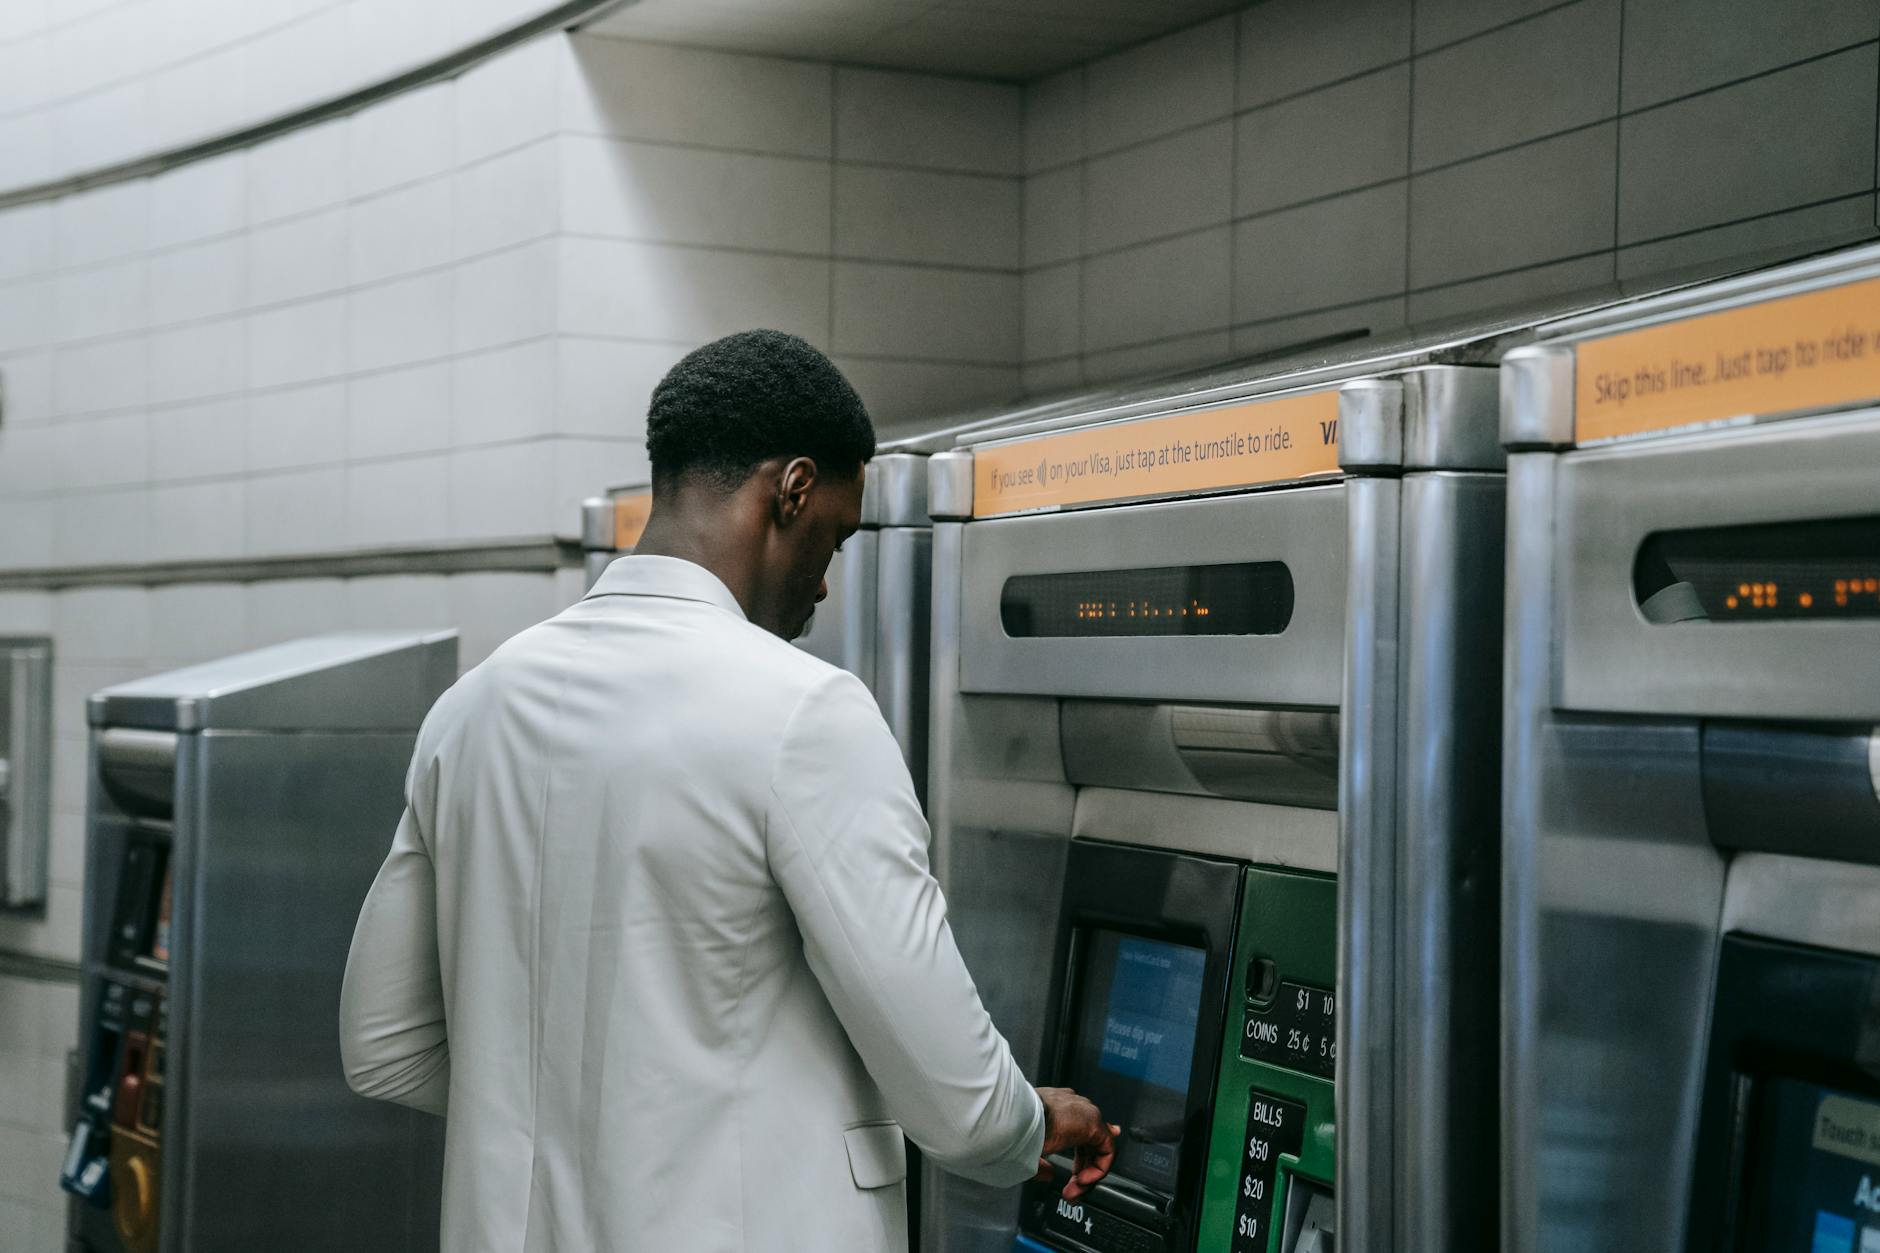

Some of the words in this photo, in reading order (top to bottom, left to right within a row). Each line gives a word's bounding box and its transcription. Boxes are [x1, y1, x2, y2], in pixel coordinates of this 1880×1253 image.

[1595, 372, 1631, 407] Skip
[1634, 366, 1665, 397] this
[1670, 358, 1709, 388] line.
[1714, 350, 1753, 384] Just
[1756, 345, 1791, 378] tap
[1795, 339, 1819, 368] to
[1822, 329, 1865, 361] ride
[1320, 420, 1336, 445] VI
[991, 468, 998, 489] If
[999, 470, 1016, 494] you
[1018, 467, 1034, 486] see
[1050, 462, 1063, 481] on
[1064, 459, 1089, 484] your
[1089, 452, 1113, 476] Visa,
[1114, 449, 1136, 477] just
[1137, 449, 1156, 472] tap
[1158, 444, 1169, 466] at
[1171, 440, 1192, 463] the
[1193, 432, 1245, 461] turnstile
[1247, 432, 1261, 454] to
[1263, 425, 1293, 452] ride.
[1297, 988, 1310, 1010] $1
[1246, 1019, 1279, 1044] COINS
[1253, 1101, 1283, 1128] BILLS
[1249, 1136, 1269, 1161] $50
[1244, 1174, 1264, 1200] $20
[1056, 1198, 1084, 1223] AUDIO
[1239, 1213, 1257, 1239] $10
